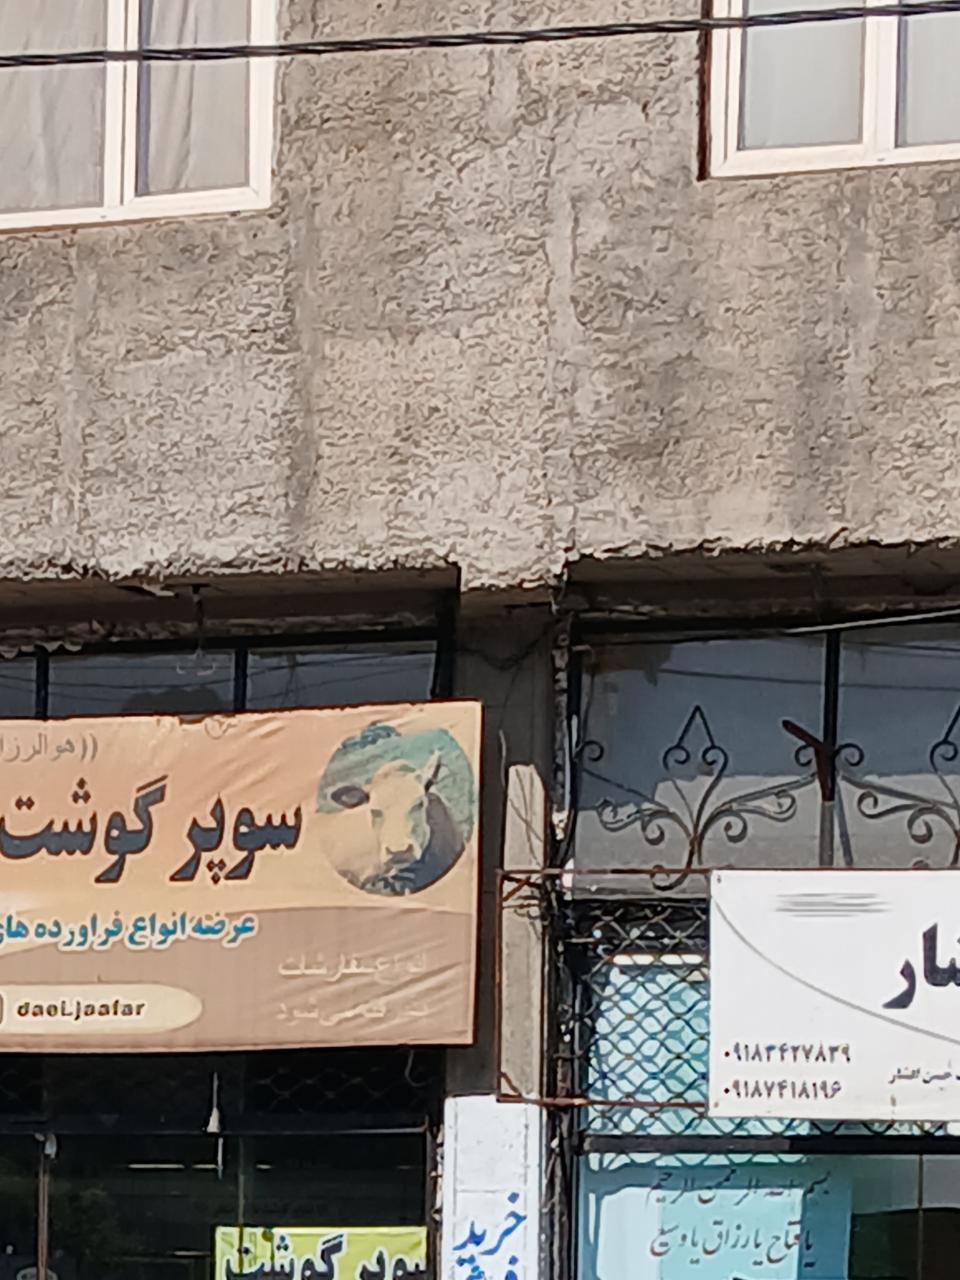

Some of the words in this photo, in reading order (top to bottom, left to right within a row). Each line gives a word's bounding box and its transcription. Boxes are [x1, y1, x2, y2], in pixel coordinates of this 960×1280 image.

[170, 791, 303, 885] سوپر
[127, 911, 188, 946] انواع
[191, 911, 257, 944] عرضه
[453, 1191, 527, 1266] خرید
